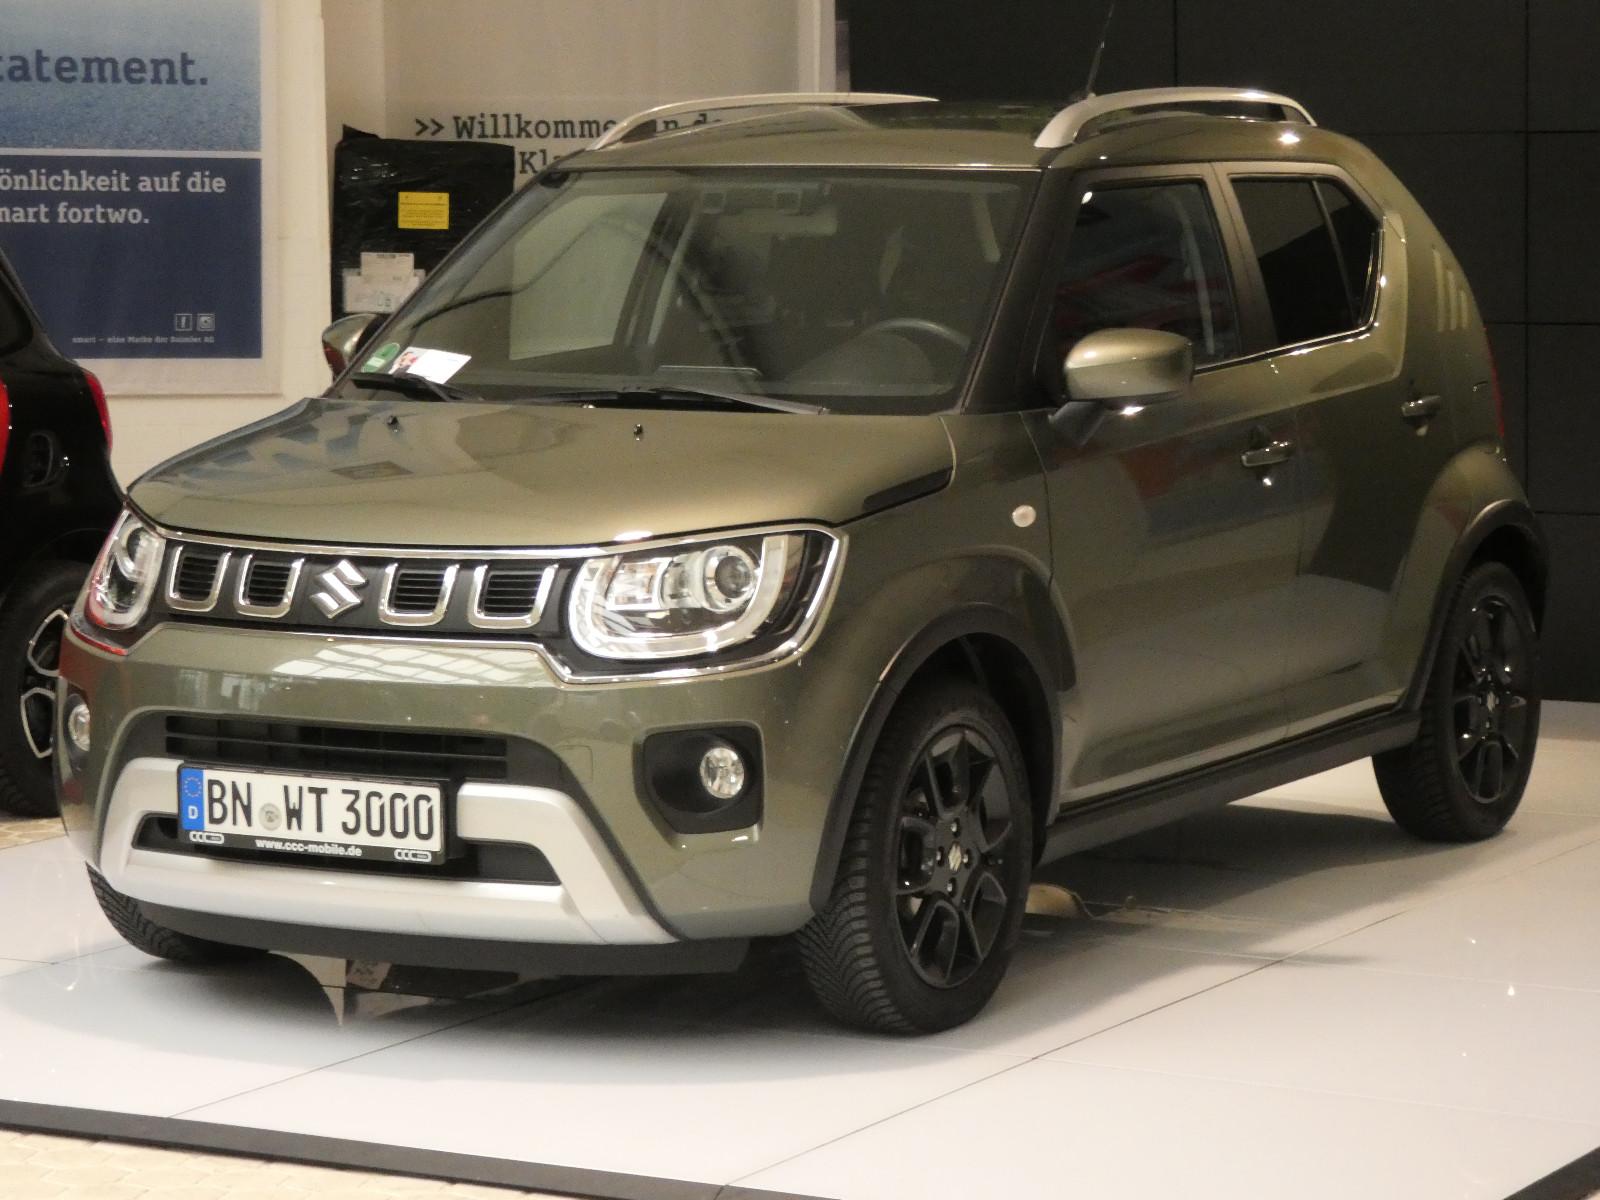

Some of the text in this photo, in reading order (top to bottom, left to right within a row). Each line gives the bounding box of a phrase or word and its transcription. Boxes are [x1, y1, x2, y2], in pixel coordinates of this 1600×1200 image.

[0, 49, 208, 86] atement.
[453, 113, 617, 140] Willkomme
[519, 148, 563, 174] Kl
[0, 169, 227, 194] önlichkeit auf die
[57, 202, 150, 224] fortwo.
[187, 778, 434, 841] D BN WT 3000
[255, 839, 363, 857] www.ccc-mobile.de
